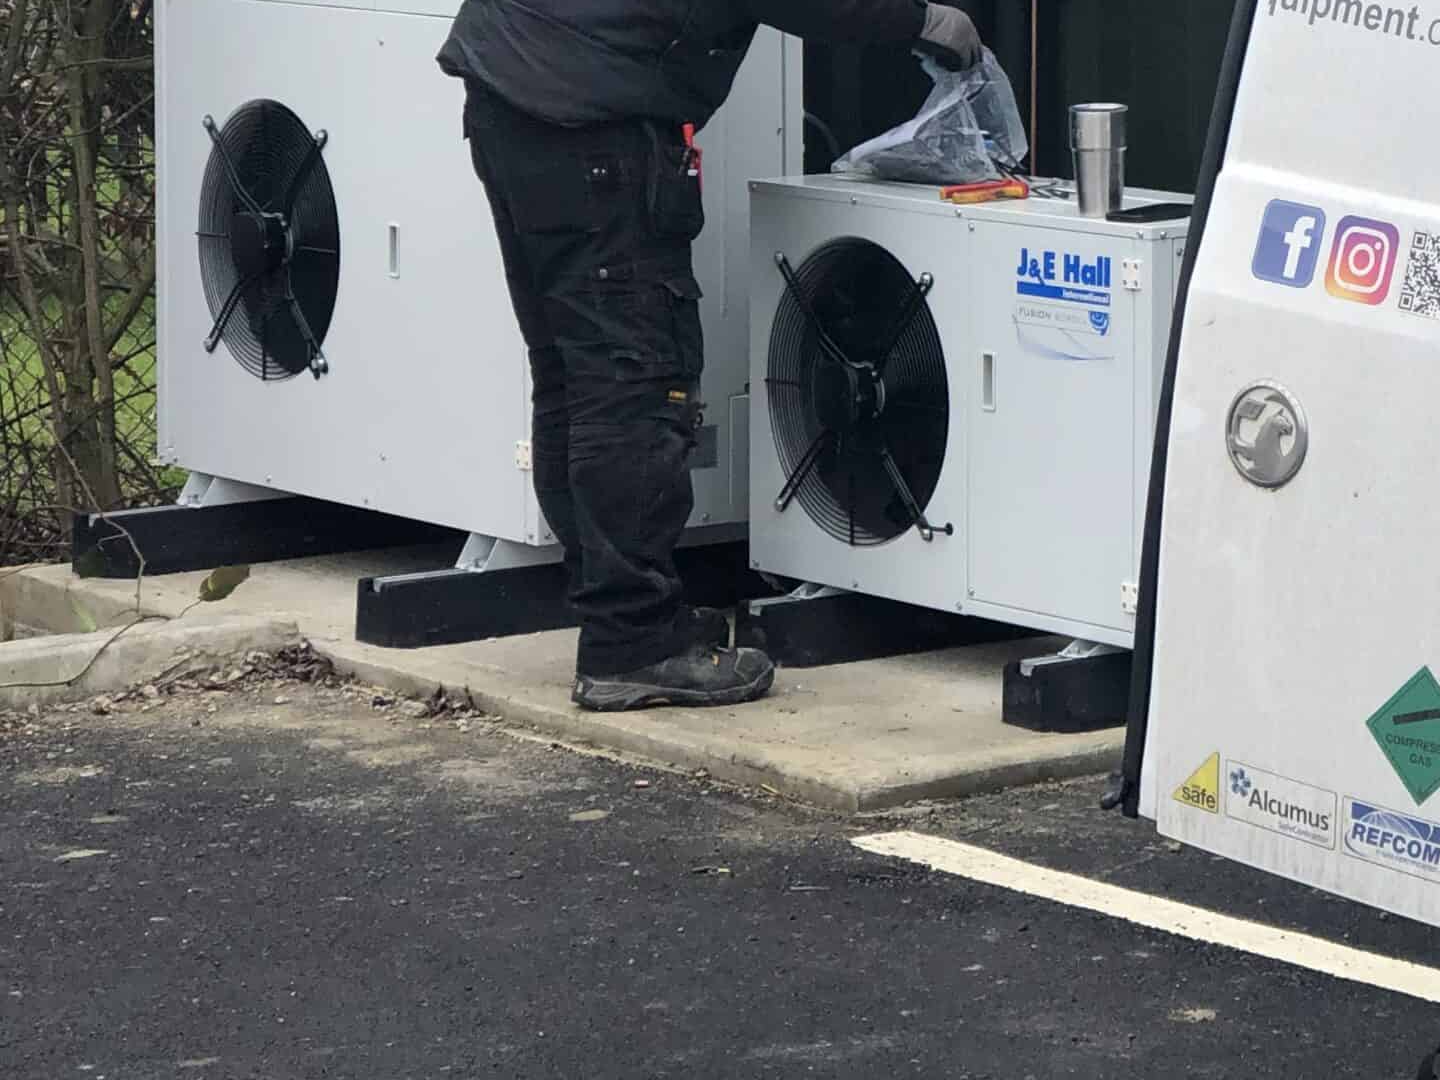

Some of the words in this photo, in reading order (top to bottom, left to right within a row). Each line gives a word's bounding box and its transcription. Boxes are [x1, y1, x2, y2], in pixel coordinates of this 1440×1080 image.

[1016, 247, 1056, 283] J&E
[1063, 253, 1111, 288] Hall
[1408, 752, 1433, 768] GAS
[1181, 785, 1216, 809] safe
[1248, 788, 1329, 831] Alcumus
